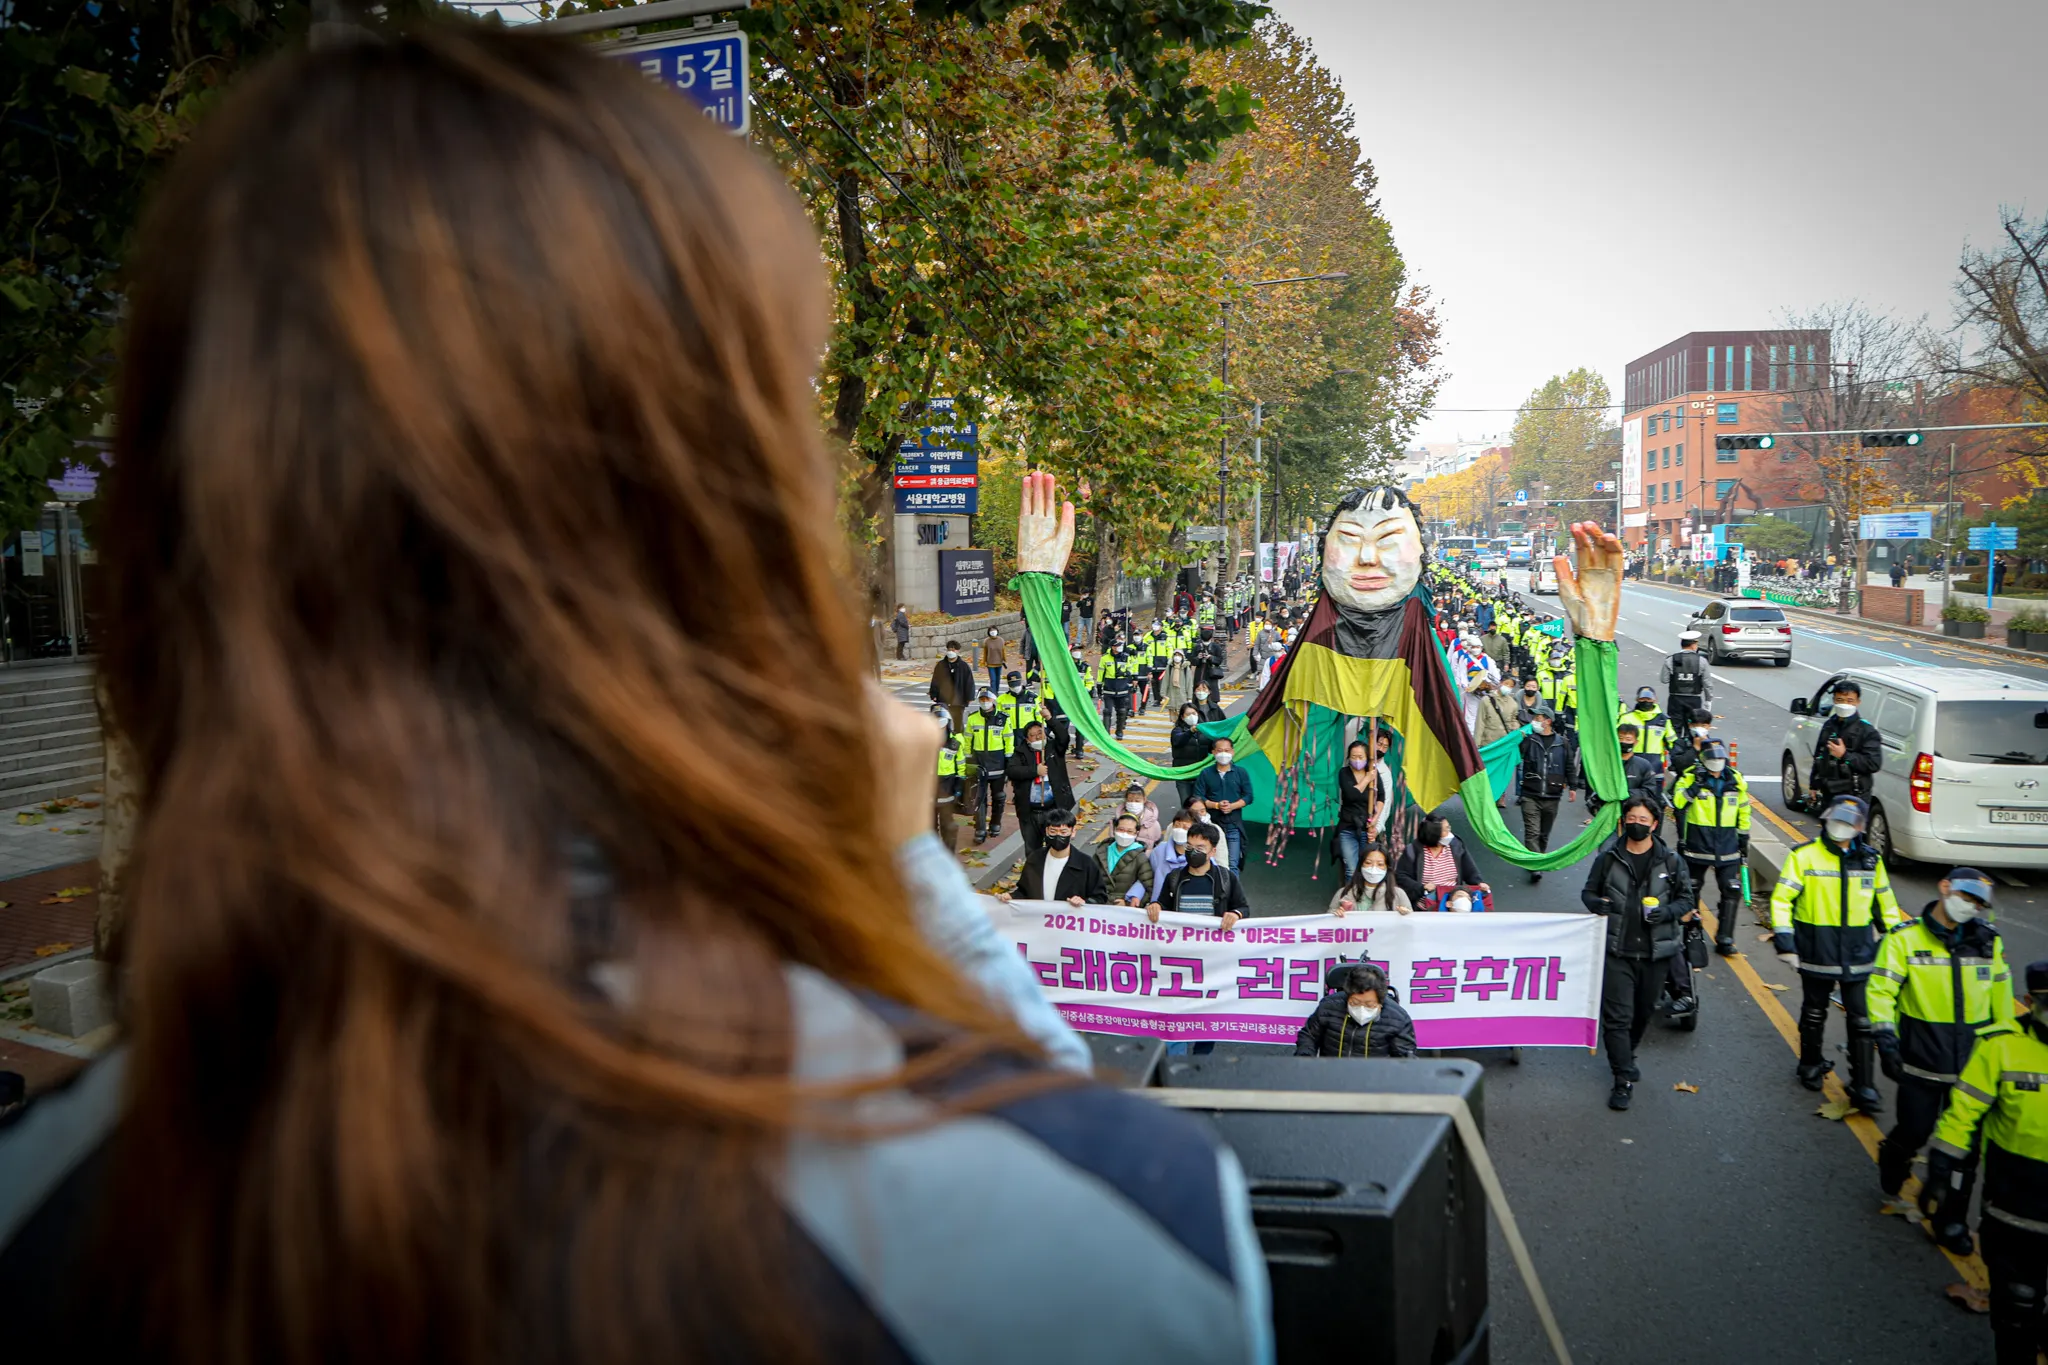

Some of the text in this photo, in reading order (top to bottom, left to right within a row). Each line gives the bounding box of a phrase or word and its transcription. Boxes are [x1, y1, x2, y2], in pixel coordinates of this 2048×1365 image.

[930, 451, 963, 460] 어린이병원
[930, 464, 951, 474] 암병원
[906, 493, 966, 505] 서울대학교병원
[917, 524, 944, 545] SNUH
[1044, 914, 1085, 932] 2021
[1089, 918, 1177, 944] Disability
[1182, 926, 1235, 943] Pride
[1237, 957, 1390, 1002] 권리
[1056, 1008, 1208, 1033] 리중심중증장애인맞춤형공공일자리,
